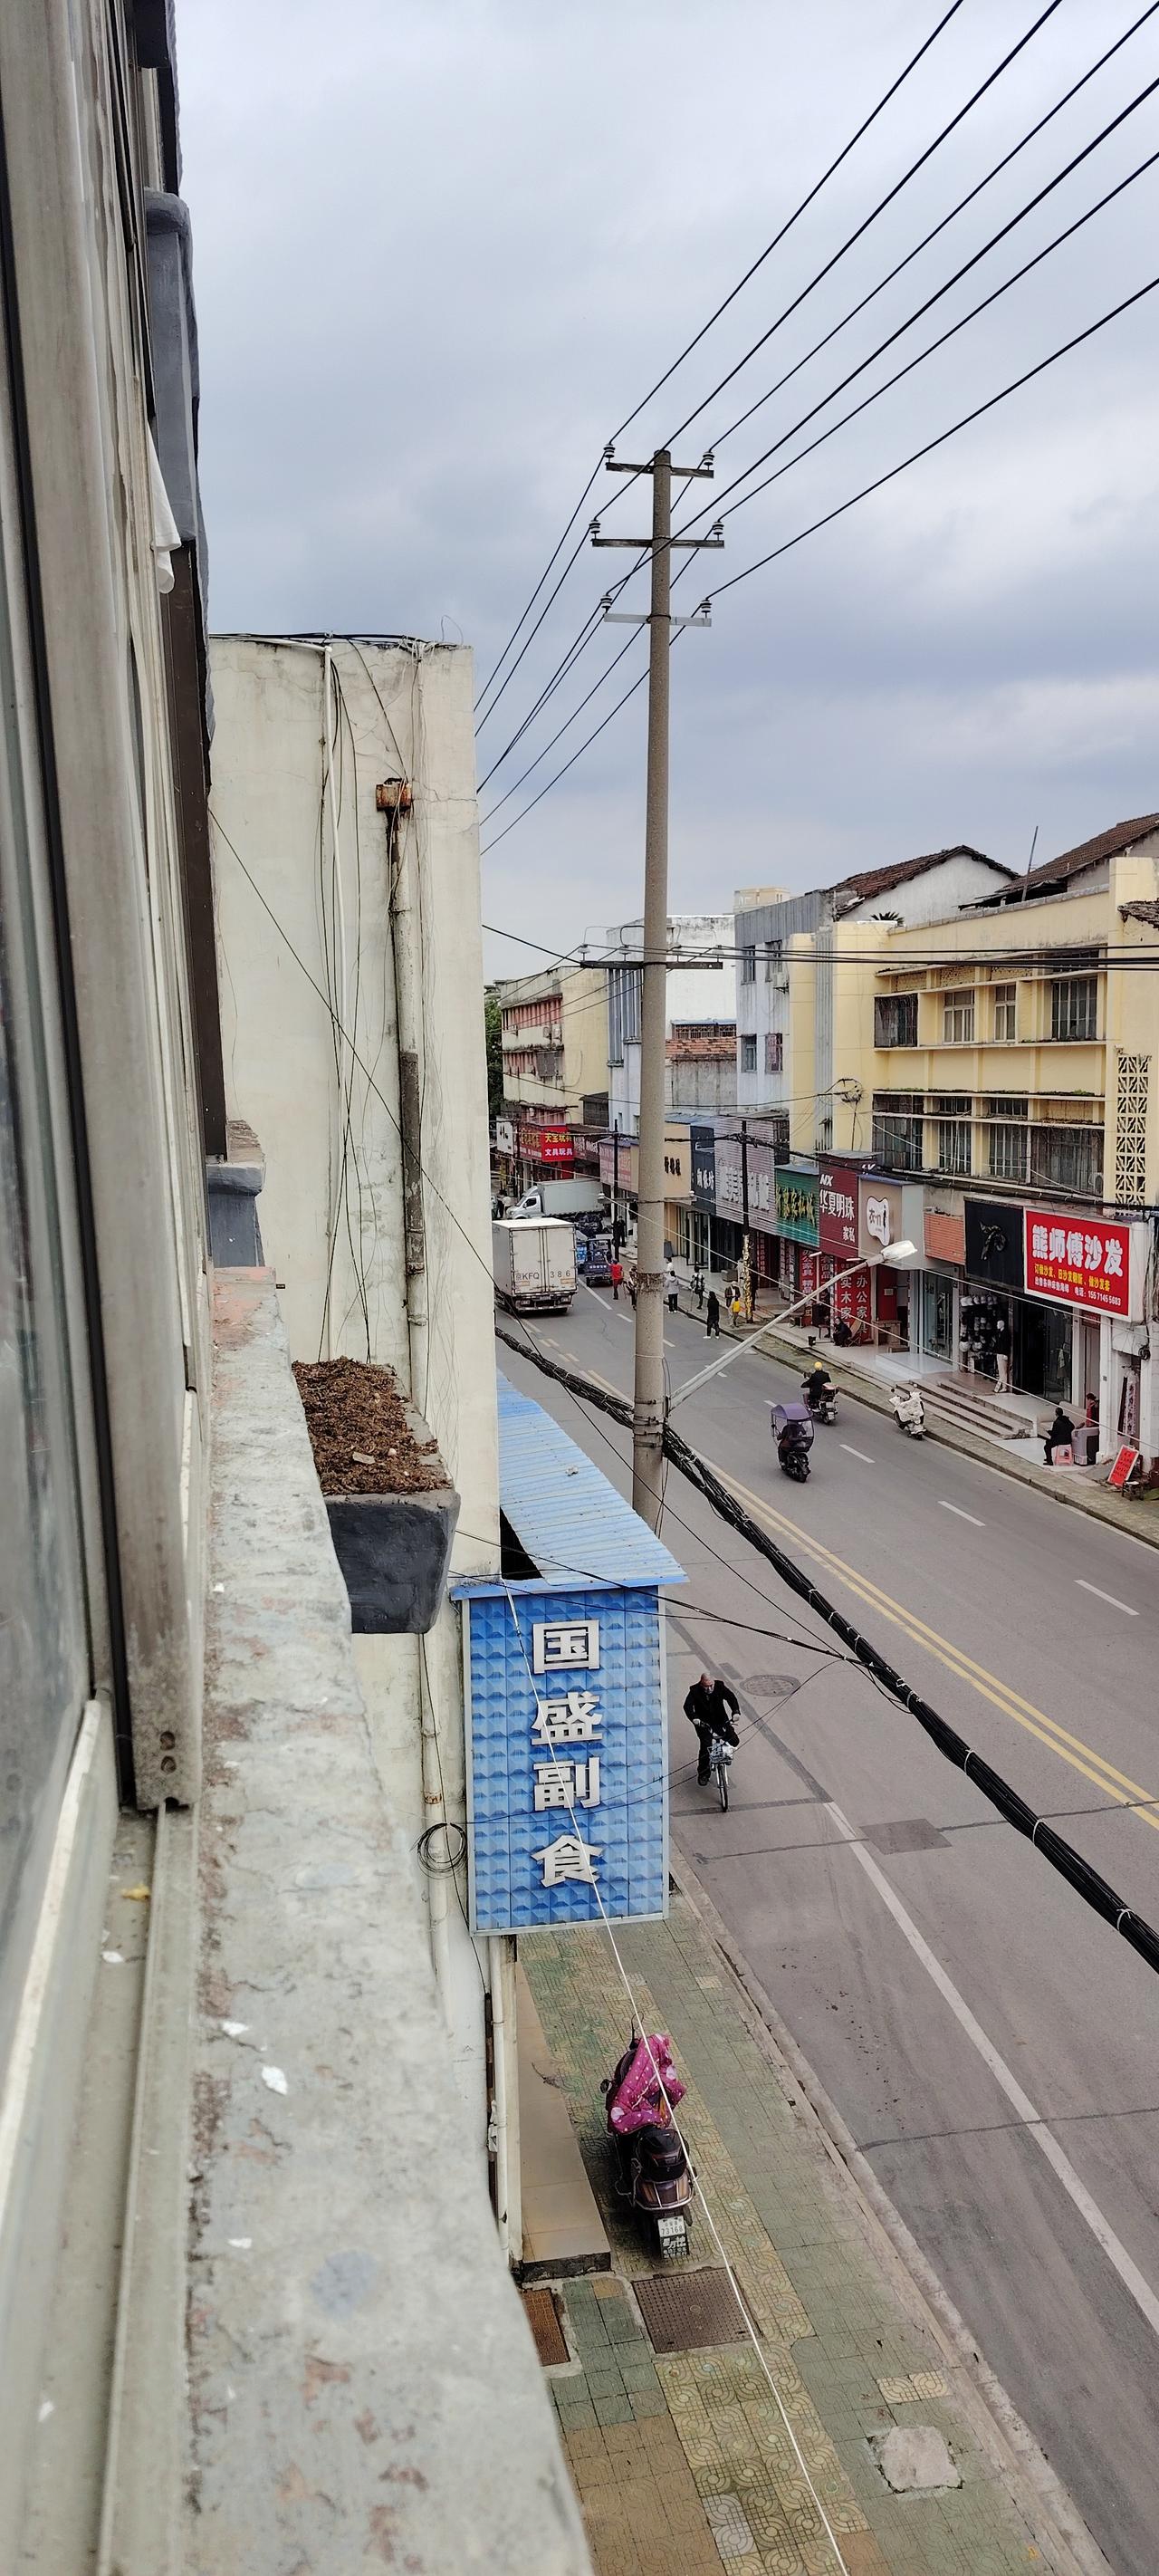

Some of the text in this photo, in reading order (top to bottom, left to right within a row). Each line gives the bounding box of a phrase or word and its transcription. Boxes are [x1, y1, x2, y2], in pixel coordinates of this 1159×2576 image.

[544, 1148, 573, 1157] 文具玩具
[819, 1188, 855, 1221] 华夏明珠
[842, 1226, 856, 1243] 家私
[1032, 1224, 1123, 1277] 熊师傅沙发
[840, 1275, 852, 1328] 实木家
[856, 1274, 868, 1334] 办公家具
[531, 1620, 603, 1888] 国盛副食
